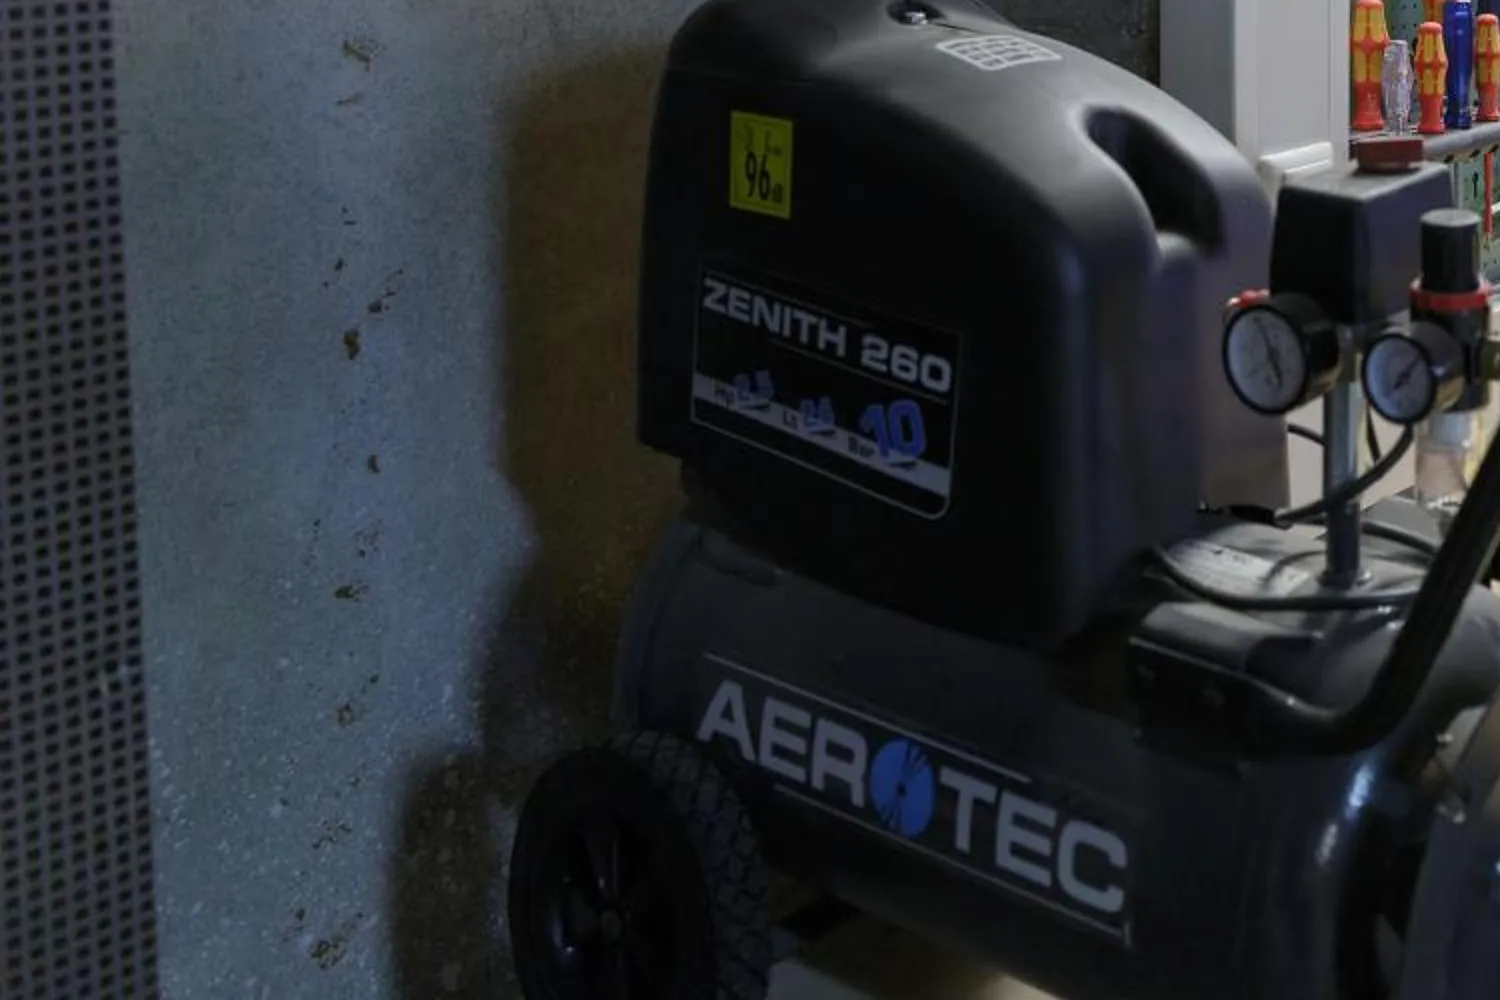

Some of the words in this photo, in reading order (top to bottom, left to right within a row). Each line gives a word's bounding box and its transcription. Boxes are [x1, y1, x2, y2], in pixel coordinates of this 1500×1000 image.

[745, 152, 770, 200] 96
[702, 277, 847, 358] ZENITH
[860, 332, 953, 394] 260
[858, 397, 928, 459] 10
